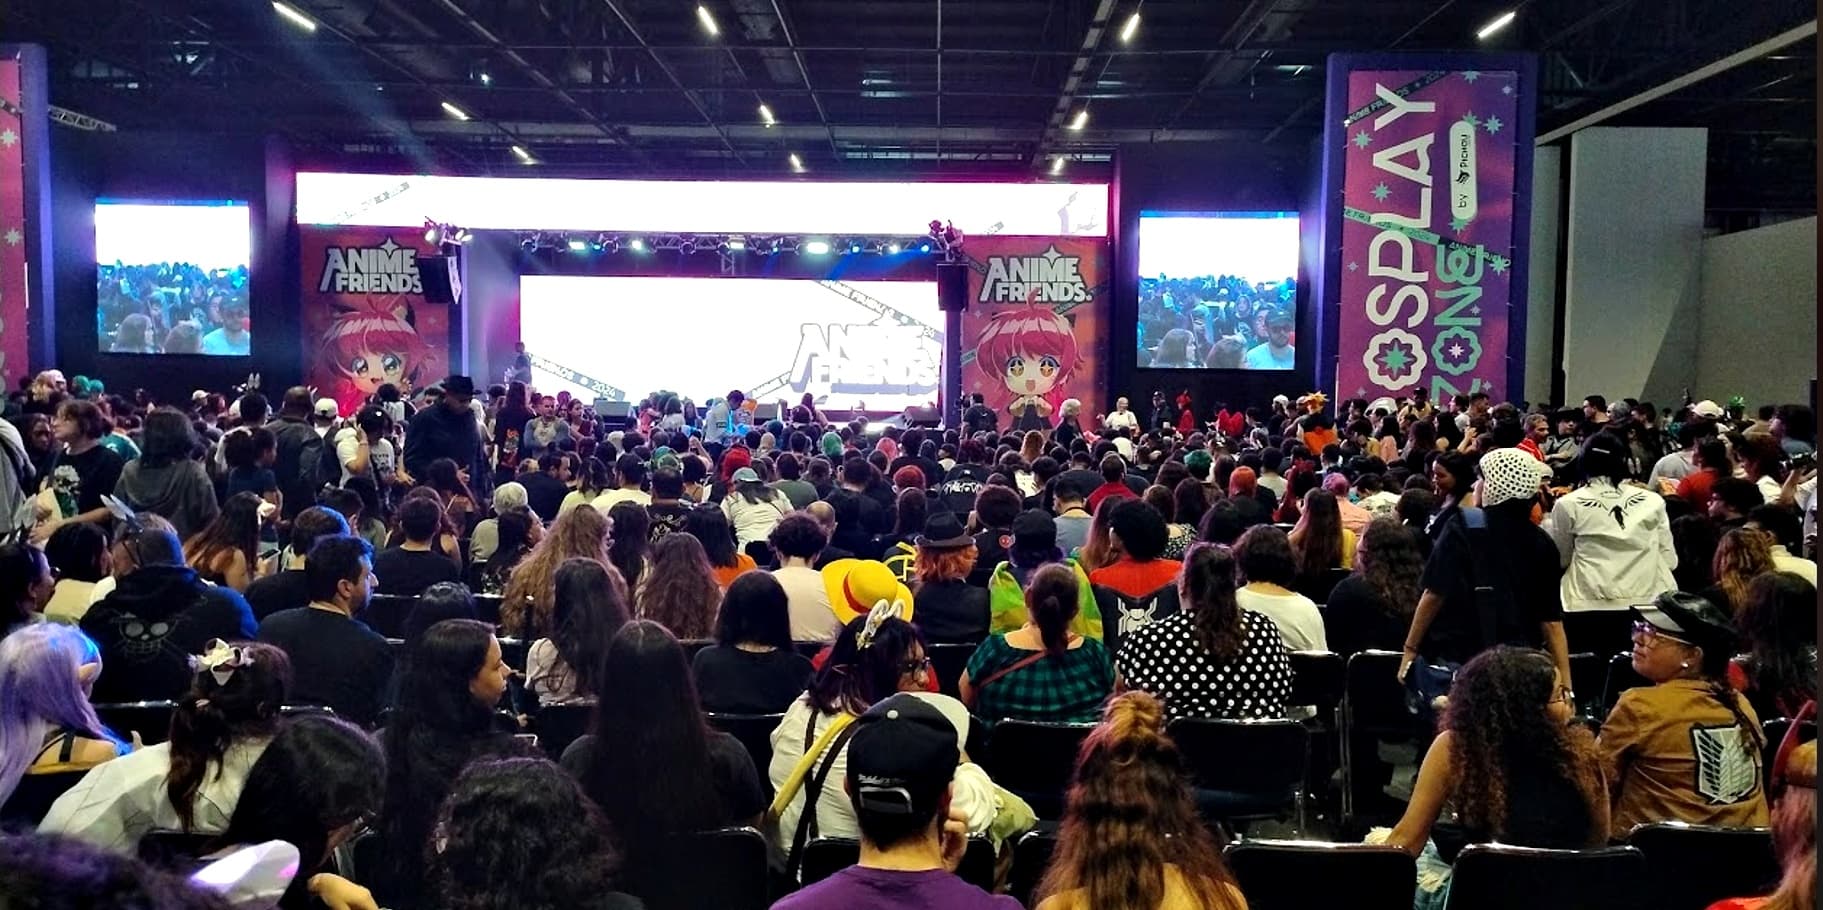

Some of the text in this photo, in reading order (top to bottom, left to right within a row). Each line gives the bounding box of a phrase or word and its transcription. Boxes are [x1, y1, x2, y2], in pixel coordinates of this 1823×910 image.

[1456, 193, 1468, 208] by
[320, 247, 420, 292] ANIME
[980, 257, 1083, 302] ANIME
[335, 272, 424, 294] FRIENDS
[591, 380, 617, 398] 2024
